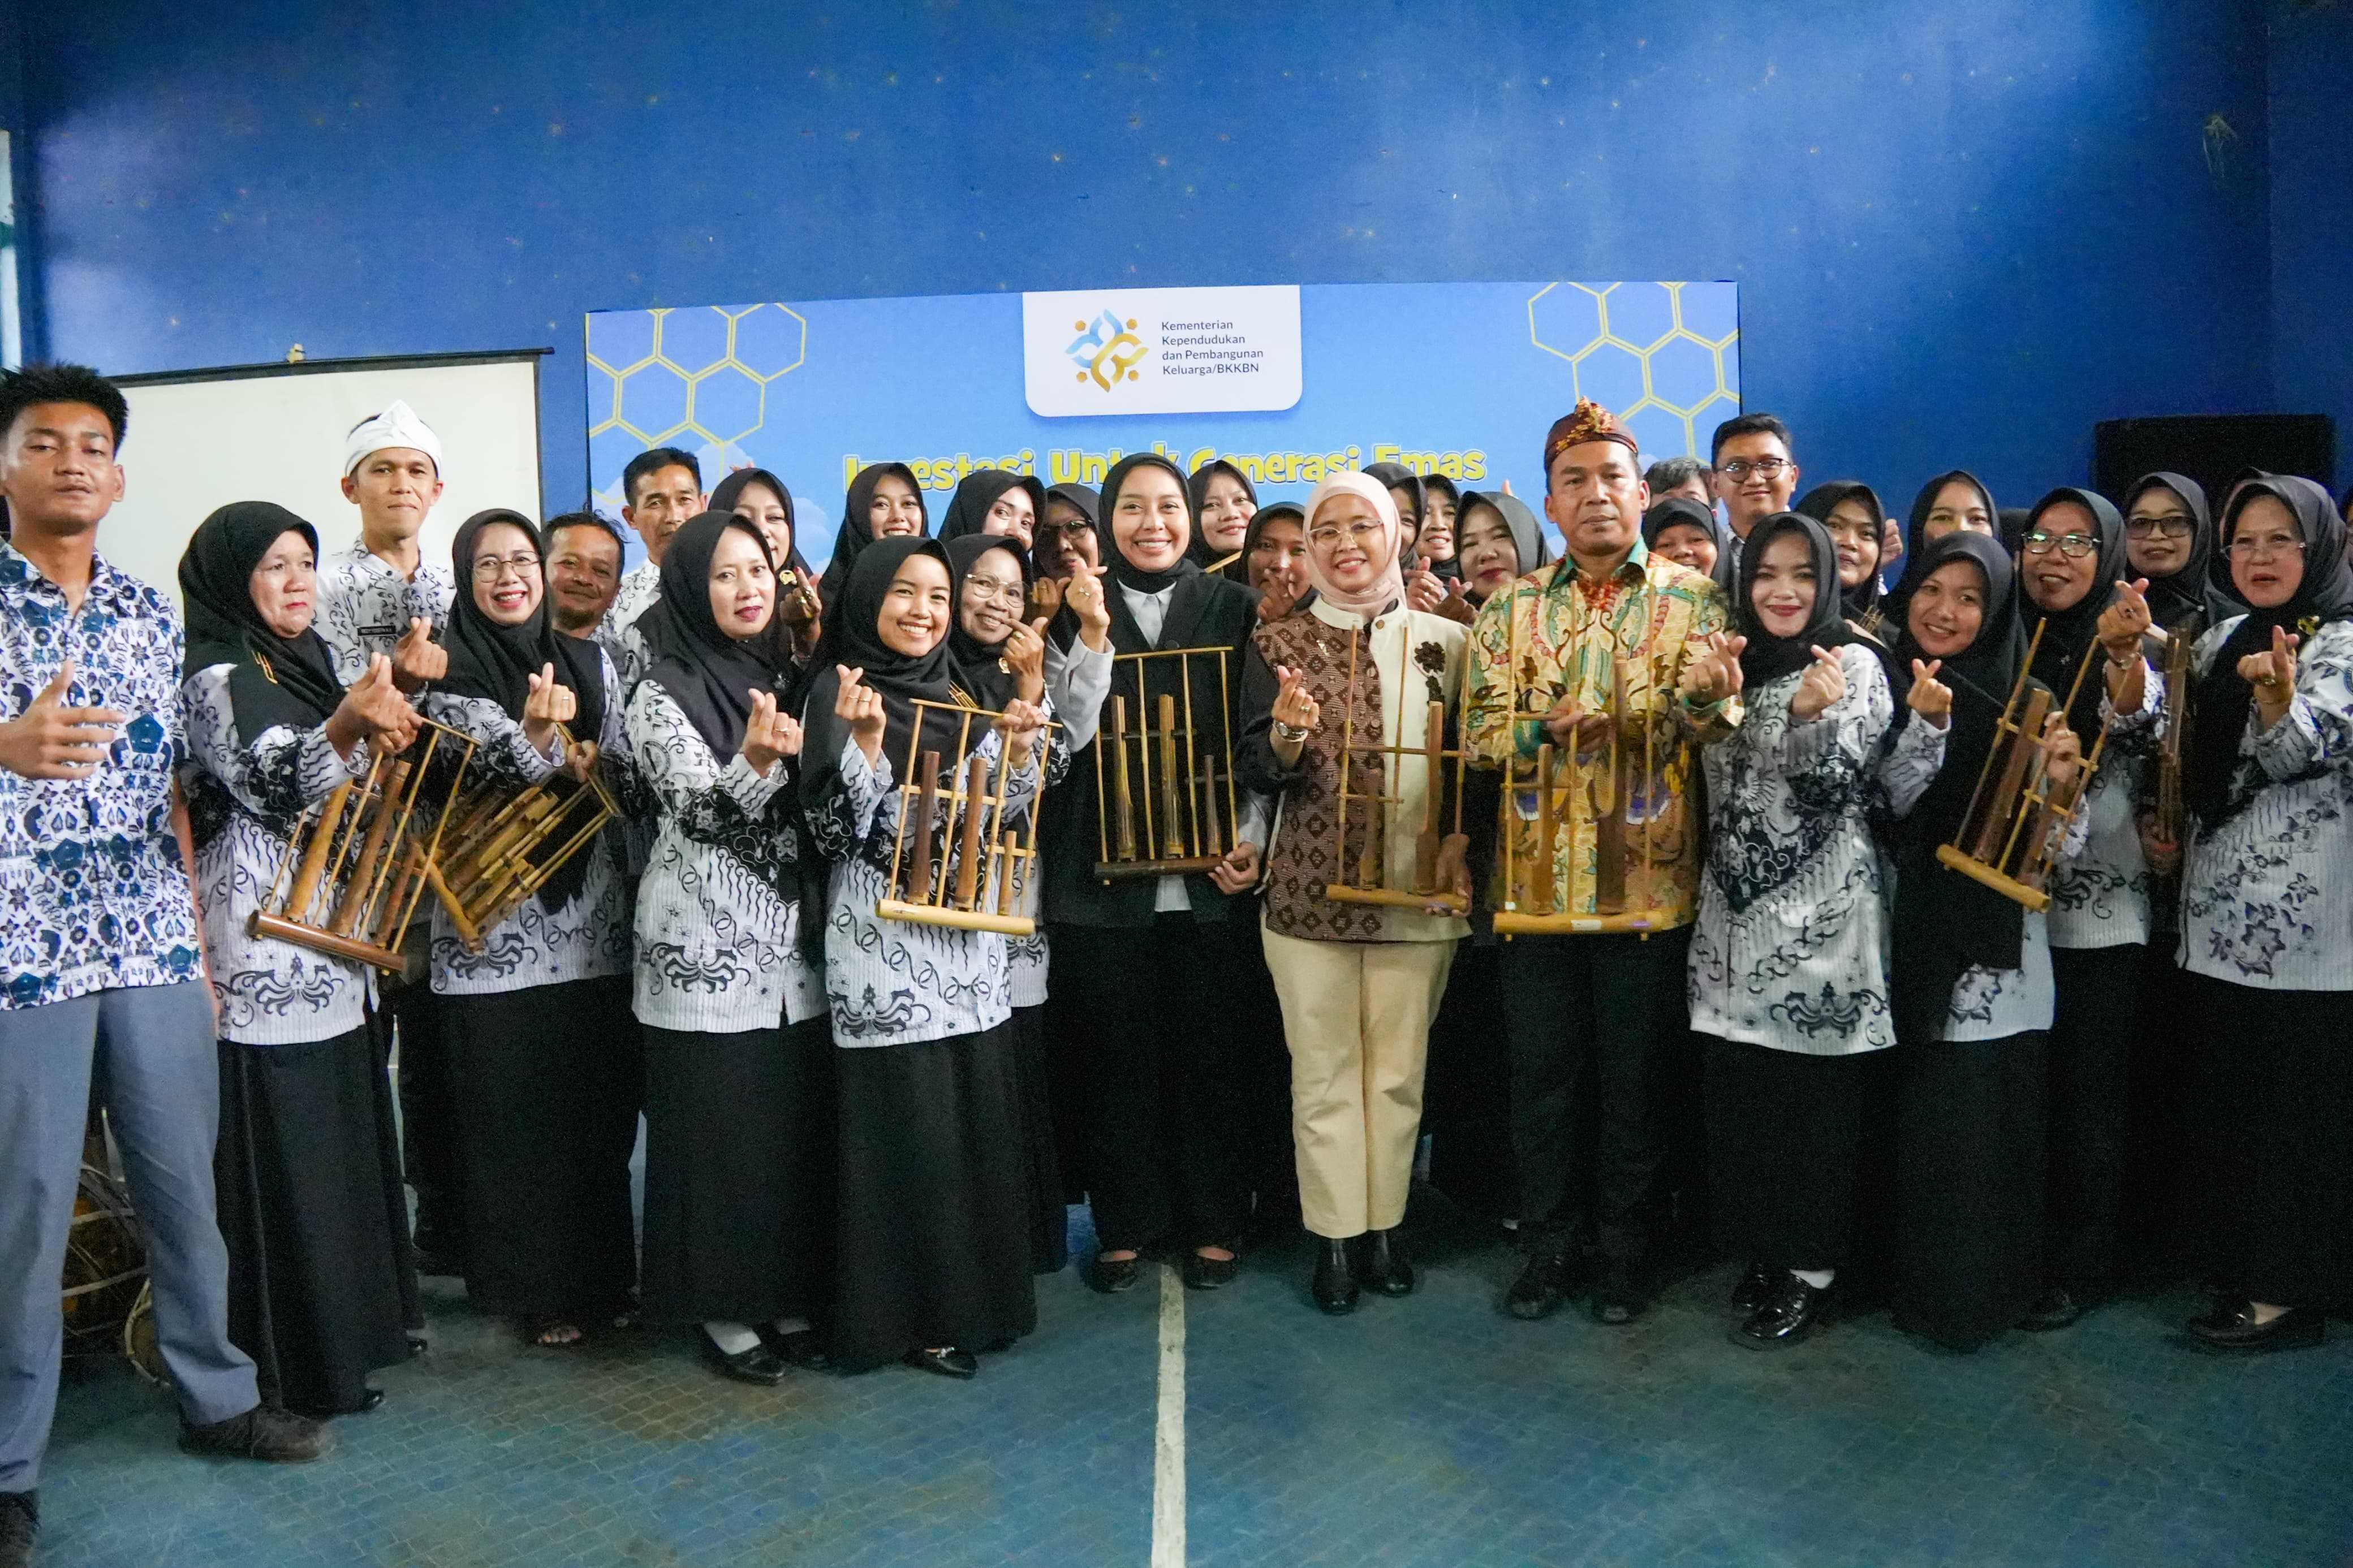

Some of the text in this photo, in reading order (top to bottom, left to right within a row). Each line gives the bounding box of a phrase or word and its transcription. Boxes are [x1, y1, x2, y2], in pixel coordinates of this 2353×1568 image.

[1161, 321, 1233, 331] Kementerian
[1162, 335, 1245, 347] Kependudukan
[1162, 349, 1264, 361] dan Pembangunan
[1162, 363, 1259, 377] Keluarga/BKKBN
[845, 451, 1034, 492] Iesti
